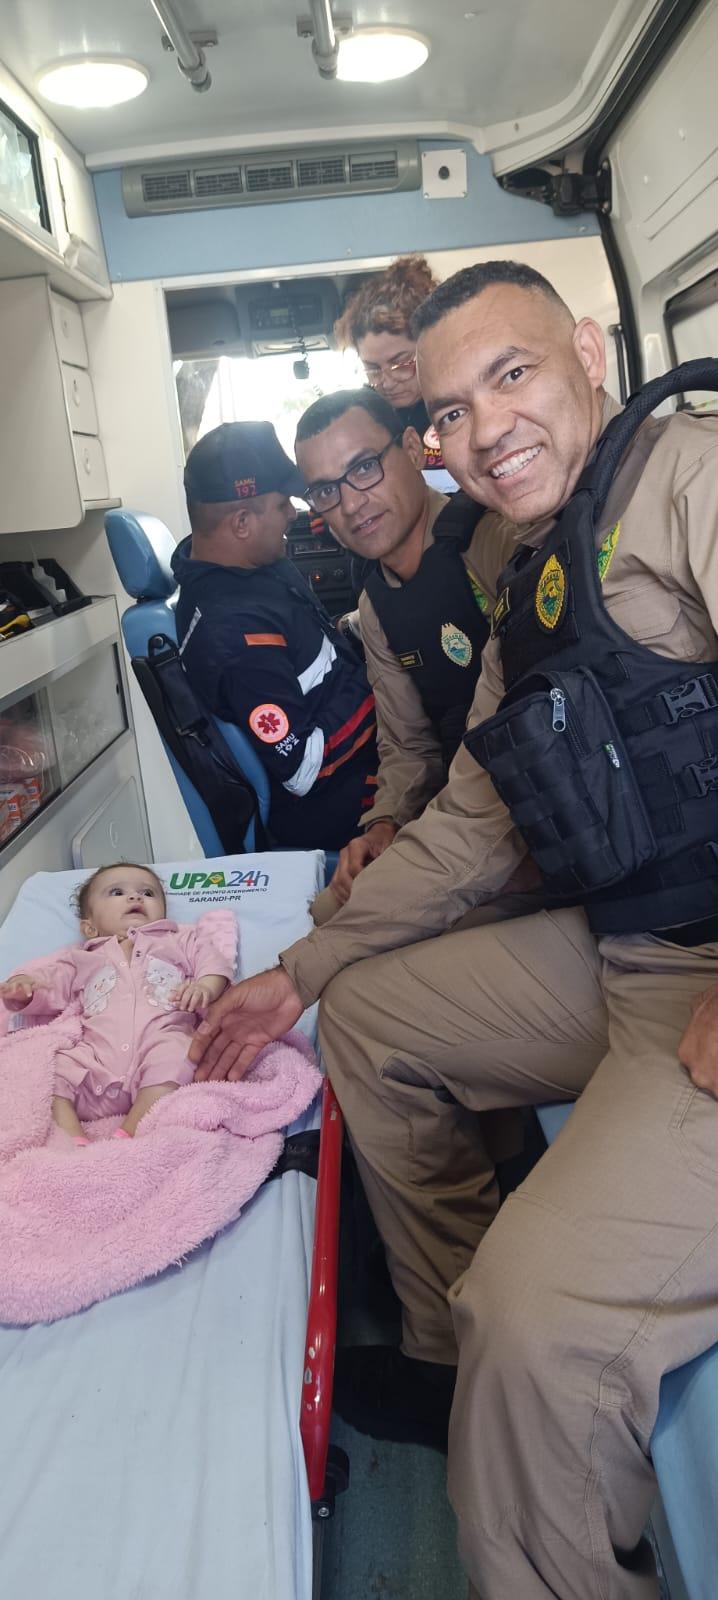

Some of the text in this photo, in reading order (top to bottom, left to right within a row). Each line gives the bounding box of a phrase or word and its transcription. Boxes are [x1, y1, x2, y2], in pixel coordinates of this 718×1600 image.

[423, 448, 442, 457] SAM
[234, 476, 256, 488] SAMU
[235, 485, 257, 497] 192
[274, 732, 296, 752] SAMU
[279, 737, 300, 757] 192
[169, 870, 270, 890] UPA 24h
[188, 895, 242, 903] SARANDI-PR
